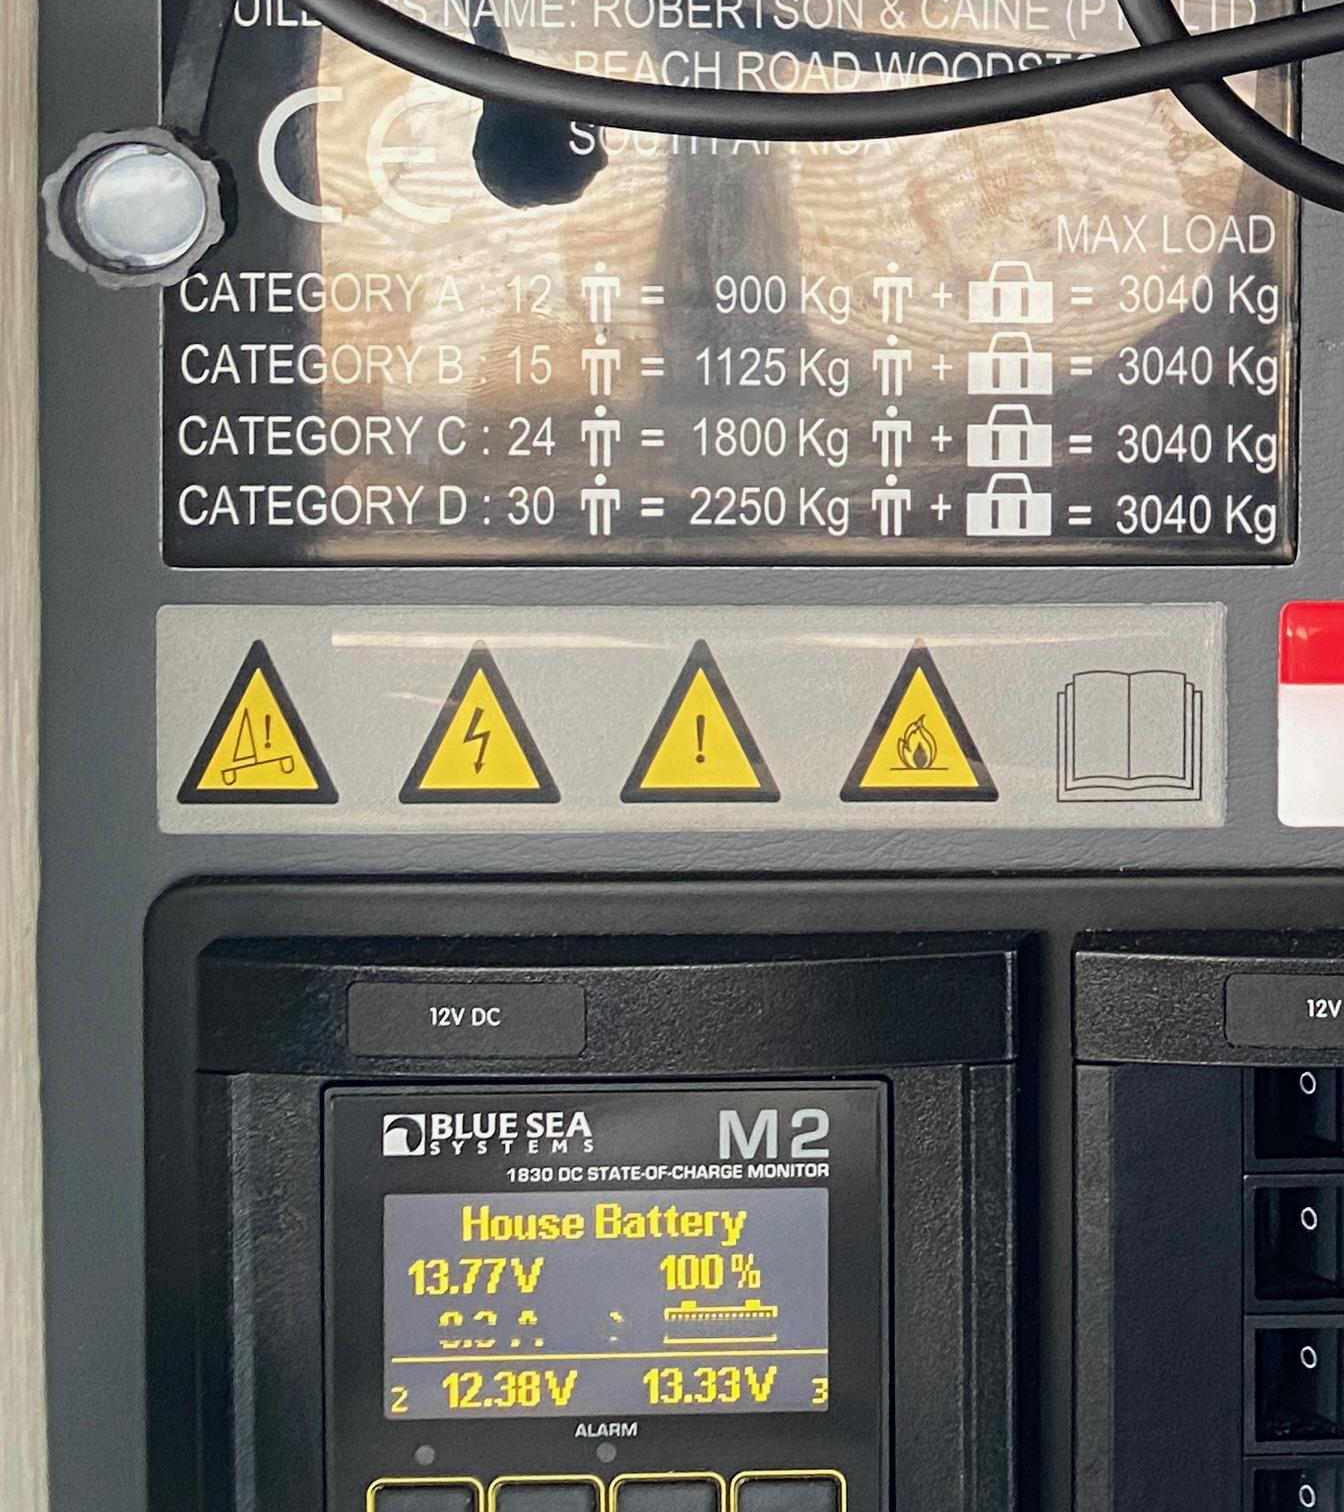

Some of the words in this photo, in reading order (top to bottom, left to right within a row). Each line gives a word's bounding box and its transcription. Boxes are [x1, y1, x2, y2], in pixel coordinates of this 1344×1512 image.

[737, 51, 861, 92] ROAD
[1057, 214, 1147, 254] MAX
[1163, 215, 1275, 254] LOAD
[178, 484, 425, 526] CATEGORY
[439, 485, 467, 525] D
[507, 485, 555, 526] 30
[689, 486, 786, 526] 2250
[799, 487, 850, 536] Kg
[1116, 494, 1212, 535] 3040
[1226, 494, 1277, 545] Kg
[1306, 998, 1342, 1018] 12V
[430, 1112, 519, 1140] BLUE
[526, 1111, 593, 1139] SEA
[430, 1138, 594, 1156] SYSTEMS
[506, 1167, 554, 1183] 1830
[558, 1166, 584, 1182] DC
[587, 1164, 743, 1182] STATE-OF-CHARGE
[747, 1162, 830, 1179] MONITOR
[461, 1206, 585, 1241] House
[593, 1202, 747, 1248] Battery
[574, 1421, 638, 1438] ALARM
